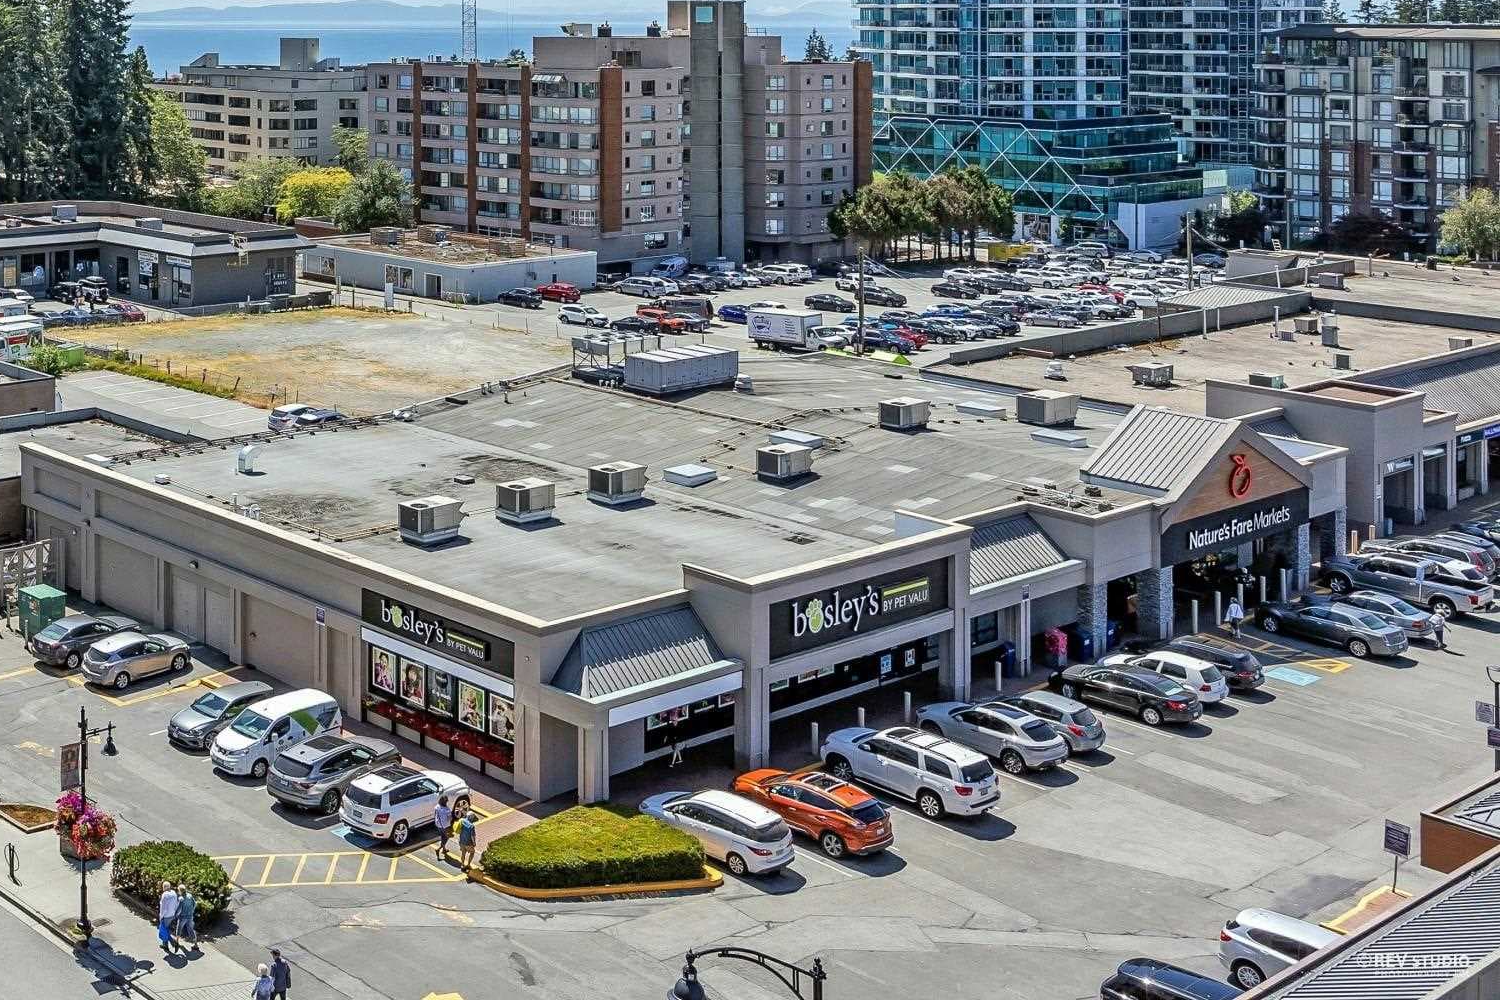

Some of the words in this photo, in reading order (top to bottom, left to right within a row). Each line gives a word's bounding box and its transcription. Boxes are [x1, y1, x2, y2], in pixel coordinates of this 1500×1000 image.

[1189, 523, 1230, 550] Nature's
[1231, 518, 1253, 538] Fare
[1253, 505, 1291, 531] Markets
[380, 600, 444, 645] bosley's
[792, 585, 879, 637] bosley's
[883, 599, 893, 612] BY
[894, 595, 907, 608] PET
[909, 590, 928, 603] VALU
[446, 639, 454, 648] BY
[455, 642, 466, 653] PET
[467, 646, 484, 660] VALU
